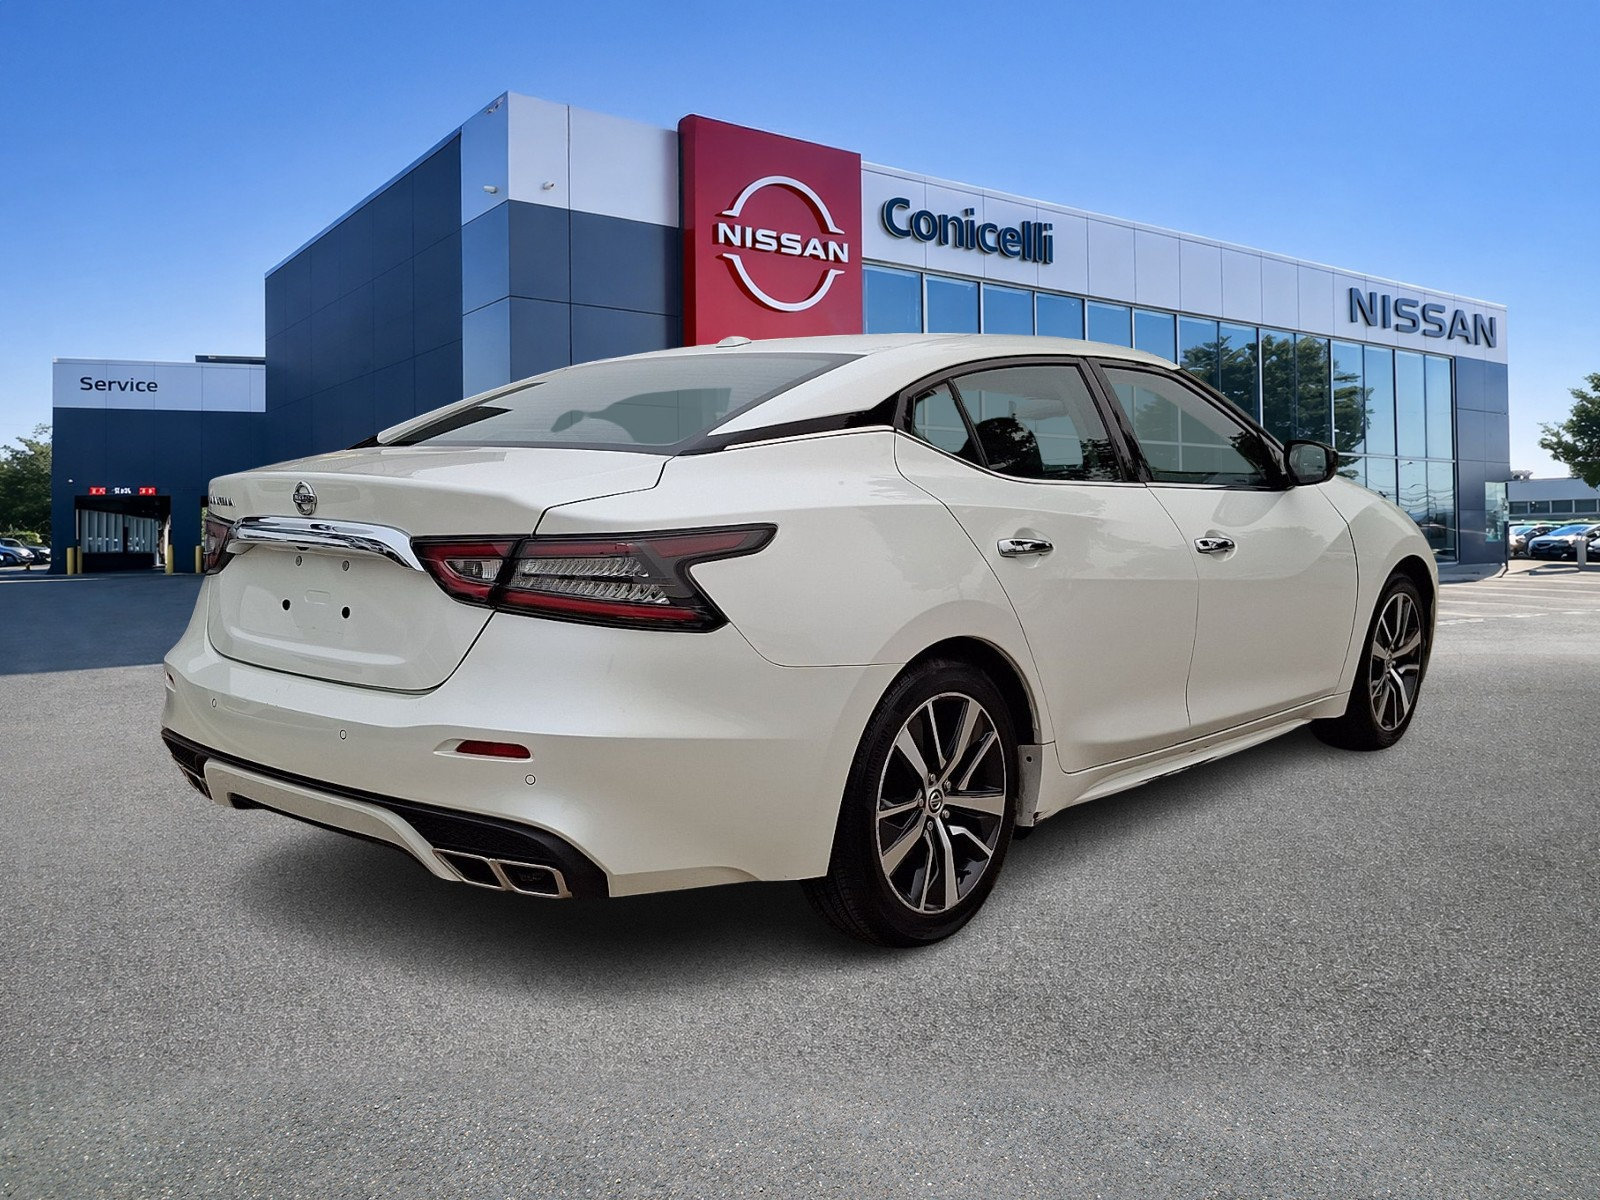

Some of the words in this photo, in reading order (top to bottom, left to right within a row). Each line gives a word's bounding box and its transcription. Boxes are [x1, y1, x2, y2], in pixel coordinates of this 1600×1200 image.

[717, 222, 849, 264] NISSAN
[882, 197, 1053, 263] Conicelli
[1349, 287, 1497, 348] NISSAN
[79, 376, 158, 392] Service
